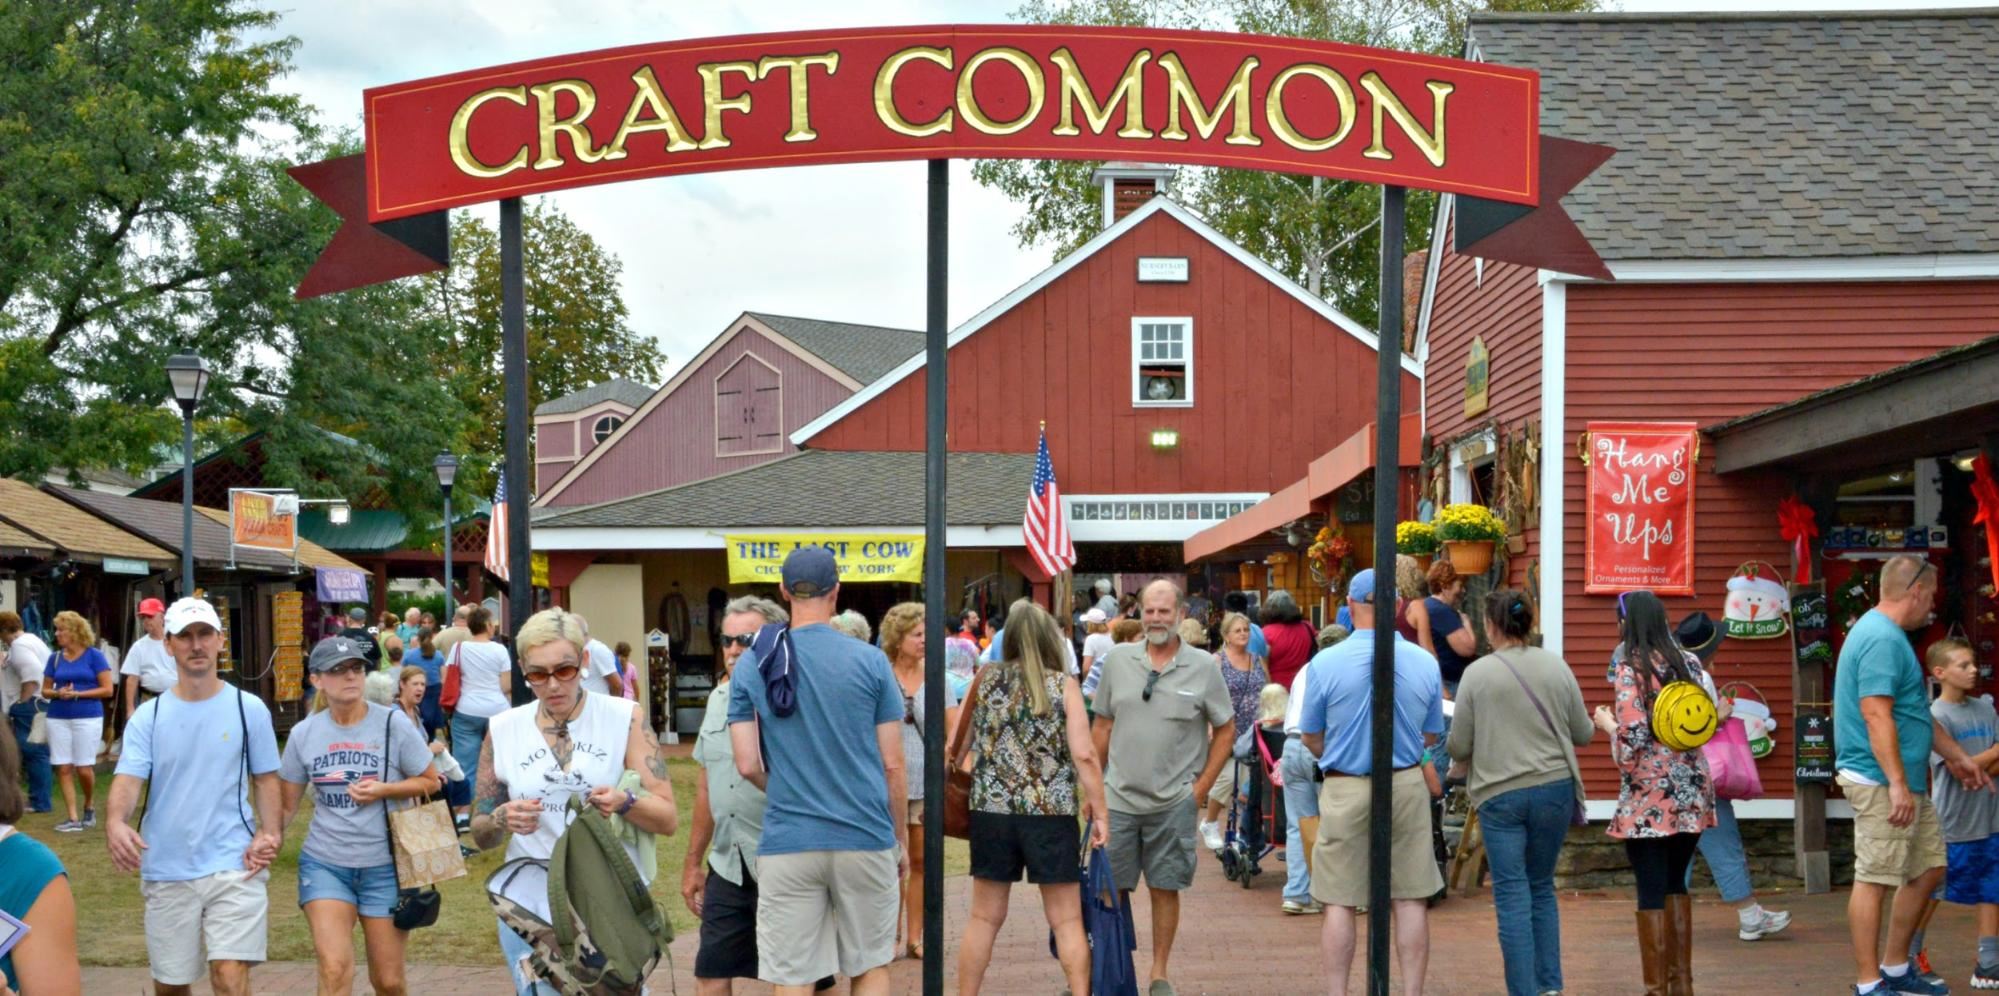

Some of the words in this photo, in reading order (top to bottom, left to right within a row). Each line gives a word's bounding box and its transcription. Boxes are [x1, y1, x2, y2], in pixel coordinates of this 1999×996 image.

[448, 49, 840, 178] CRAFT
[873, 46, 1455, 168] COMMON
[1597, 438, 1686, 485] Hang
[1612, 473, 1671, 505] Me
[1605, 512, 1673, 561] Ups
[736, 541, 781, 559] THE
[862, 541, 914, 559] COW
[857, 564, 896, 575] YORK
[1613, 565, 1666, 574] Personalized
[1595, 575, 1640, 584] Ornaments
[313, 751, 379, 771] PATRIOTS
[1797, 767, 1832, 777] Christmas
